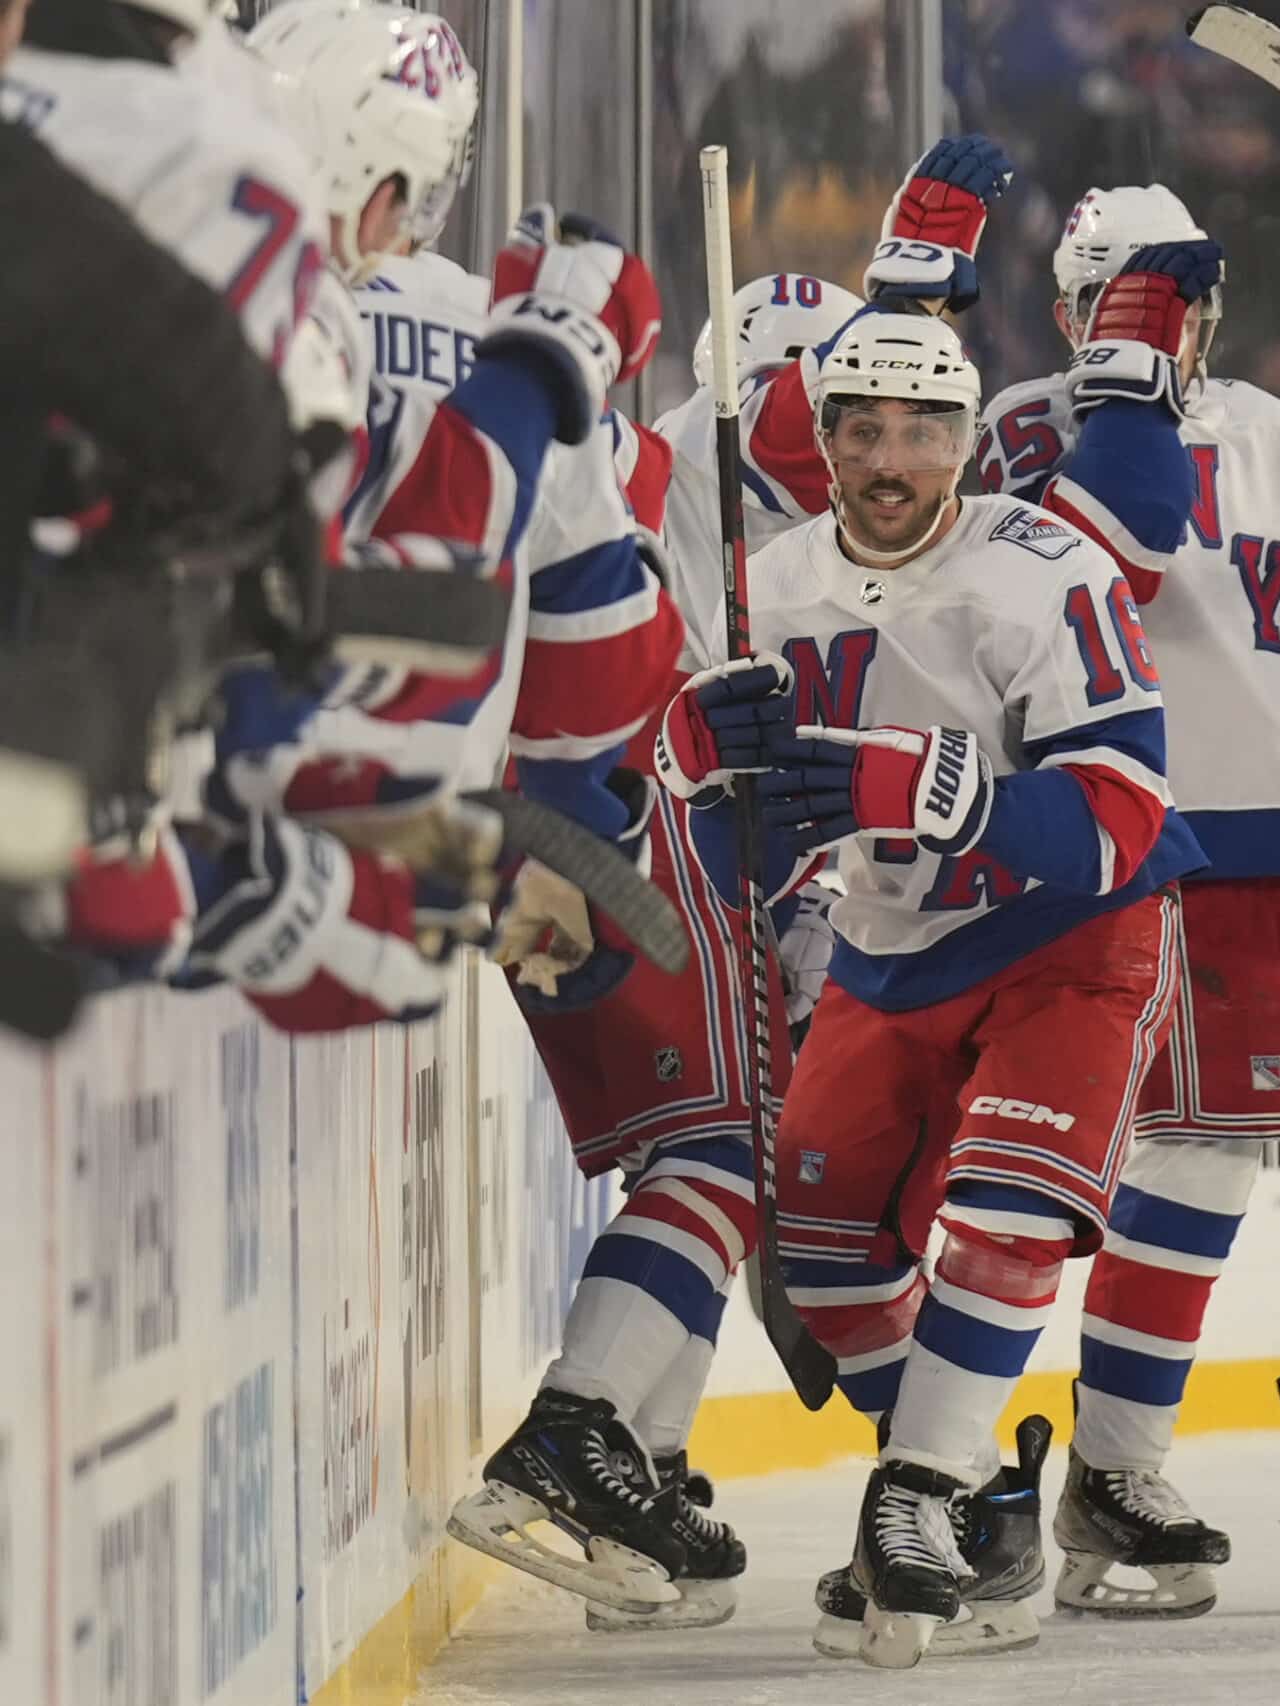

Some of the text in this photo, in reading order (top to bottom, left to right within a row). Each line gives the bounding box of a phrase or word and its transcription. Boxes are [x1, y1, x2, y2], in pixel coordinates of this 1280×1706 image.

[771, 273, 822, 309] 10
[871, 359, 923, 371] CCM
[1064, 576, 1161, 706] 16
[967, 1094, 1077, 1133] CCM
[512, 1444, 562, 1498] CCM
